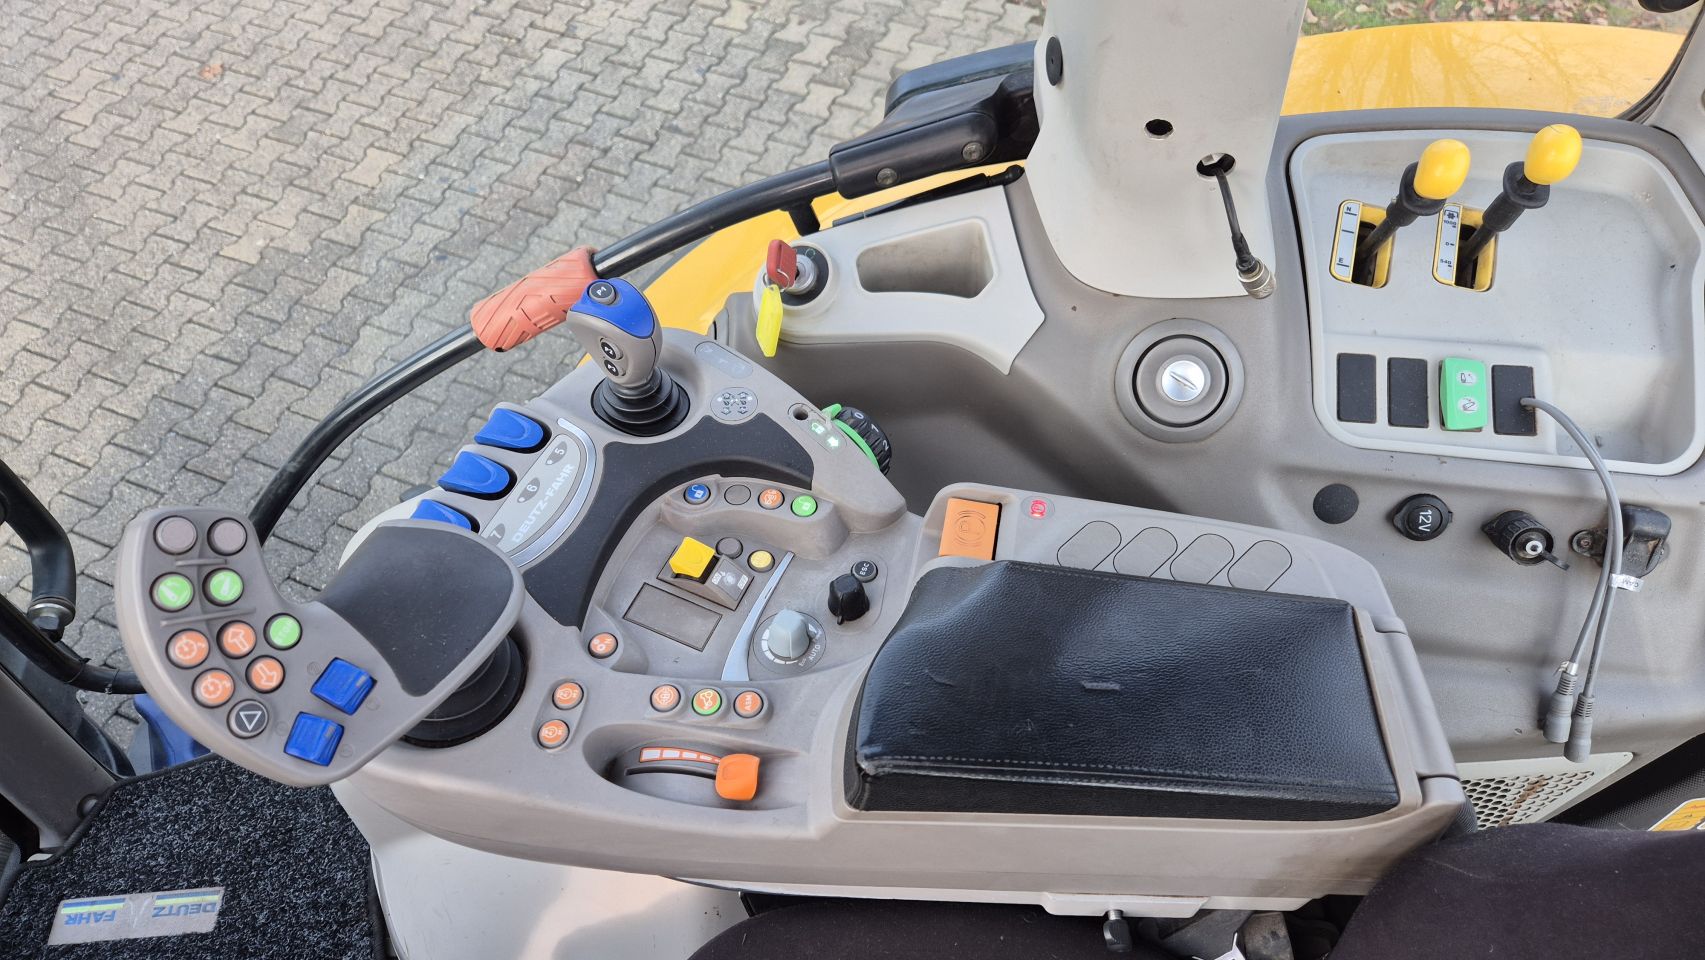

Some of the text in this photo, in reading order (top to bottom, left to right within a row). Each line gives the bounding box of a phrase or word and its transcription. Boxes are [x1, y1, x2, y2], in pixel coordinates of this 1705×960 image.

[854, 411, 864, 420] 0
[554, 447, 565, 455] 5
[526, 484, 538, 492] 6
[512, 463, 575, 543] DEUTZ-FAHR
[1418, 509, 1432, 532] 12V
[490, 529, 502, 539] 7
[860, 562, 870, 576] ESC
[808, 644, 821, 662] AUTO
[64, 902, 217, 926] DEUTZ FAHR
